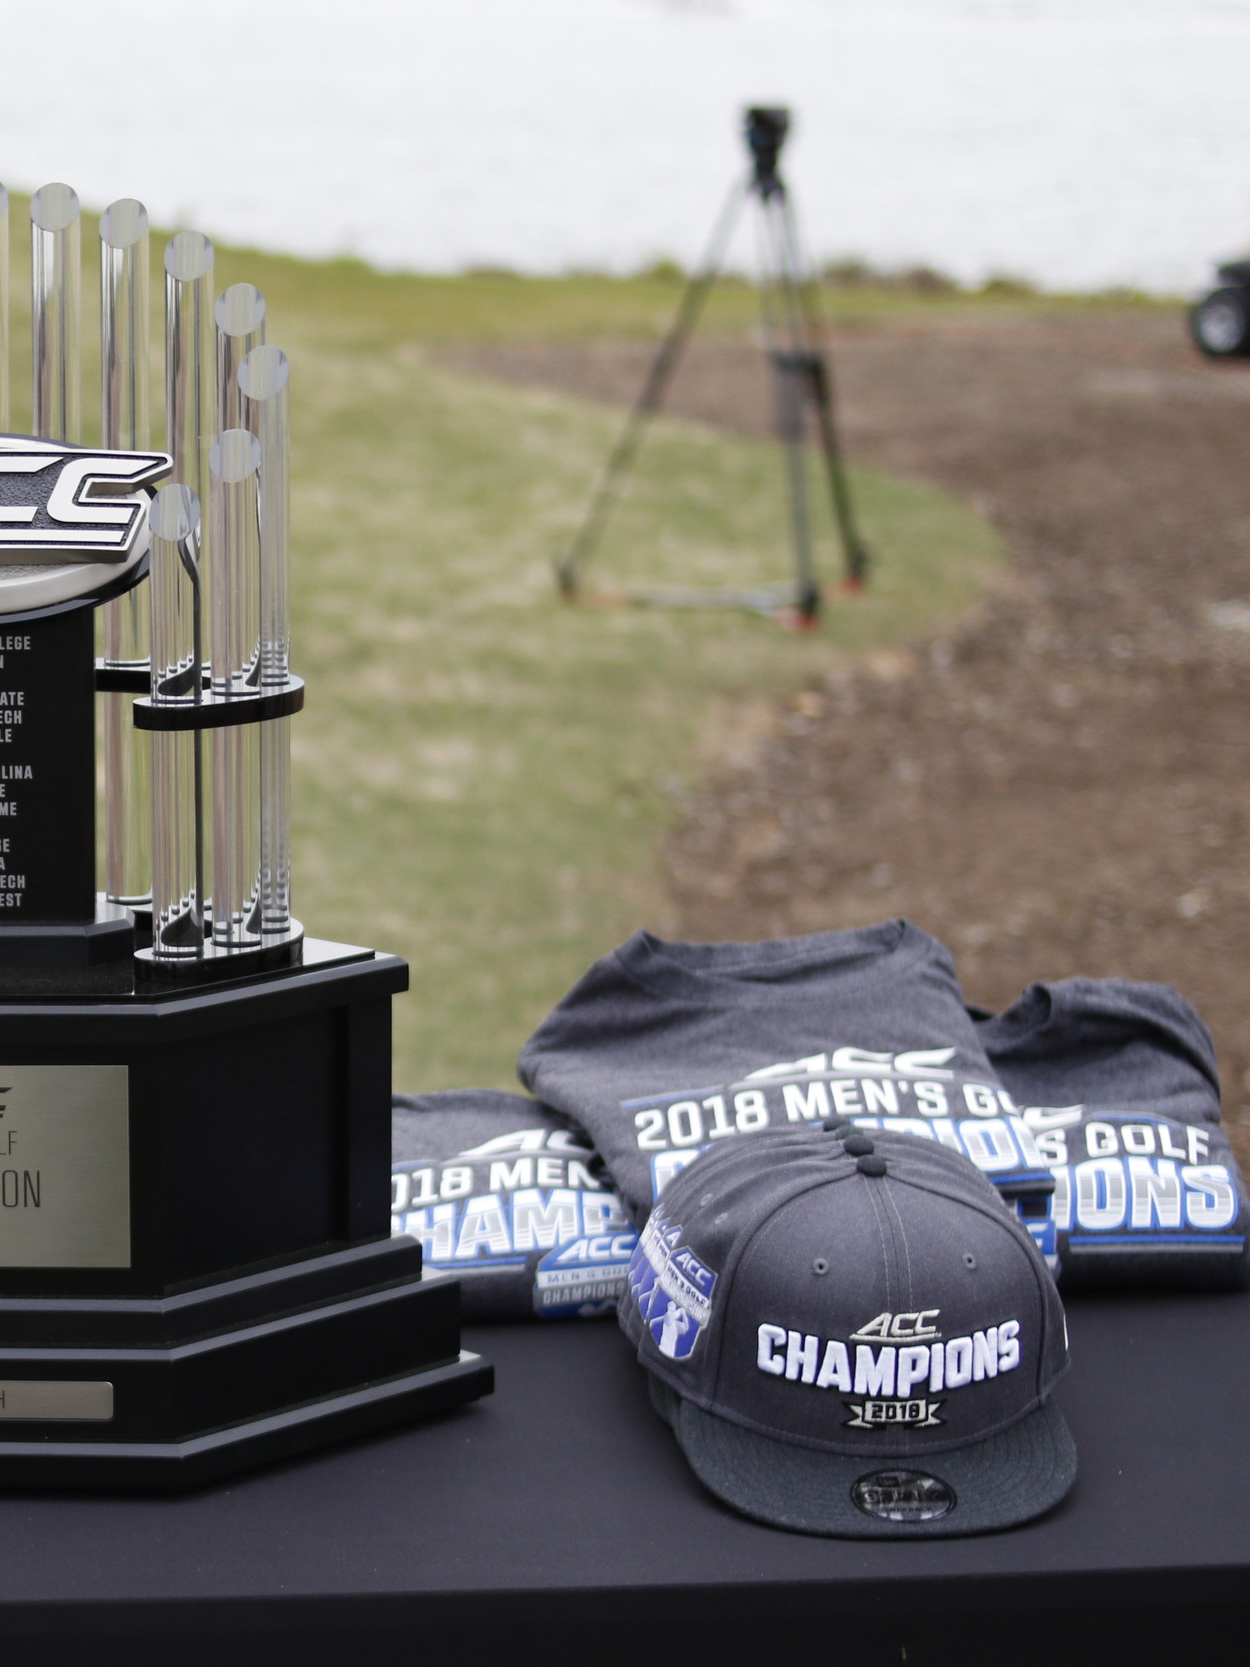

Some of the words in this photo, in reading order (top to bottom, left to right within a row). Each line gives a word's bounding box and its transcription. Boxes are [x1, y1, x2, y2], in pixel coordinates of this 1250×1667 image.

[634, 1089, 770, 1151] 2018
[783, 1079, 950, 1122] MEN'S
[1085, 1122, 1210, 1166] GOLF
[556, 1234, 637, 1262] ACC
[675, 1251, 713, 1288] ACC
[854, 1309, 941, 1338] ACC
[757, 1319, 1020, 1399] CHAMPIONS
[870, 1402, 921, 1421] 2018
